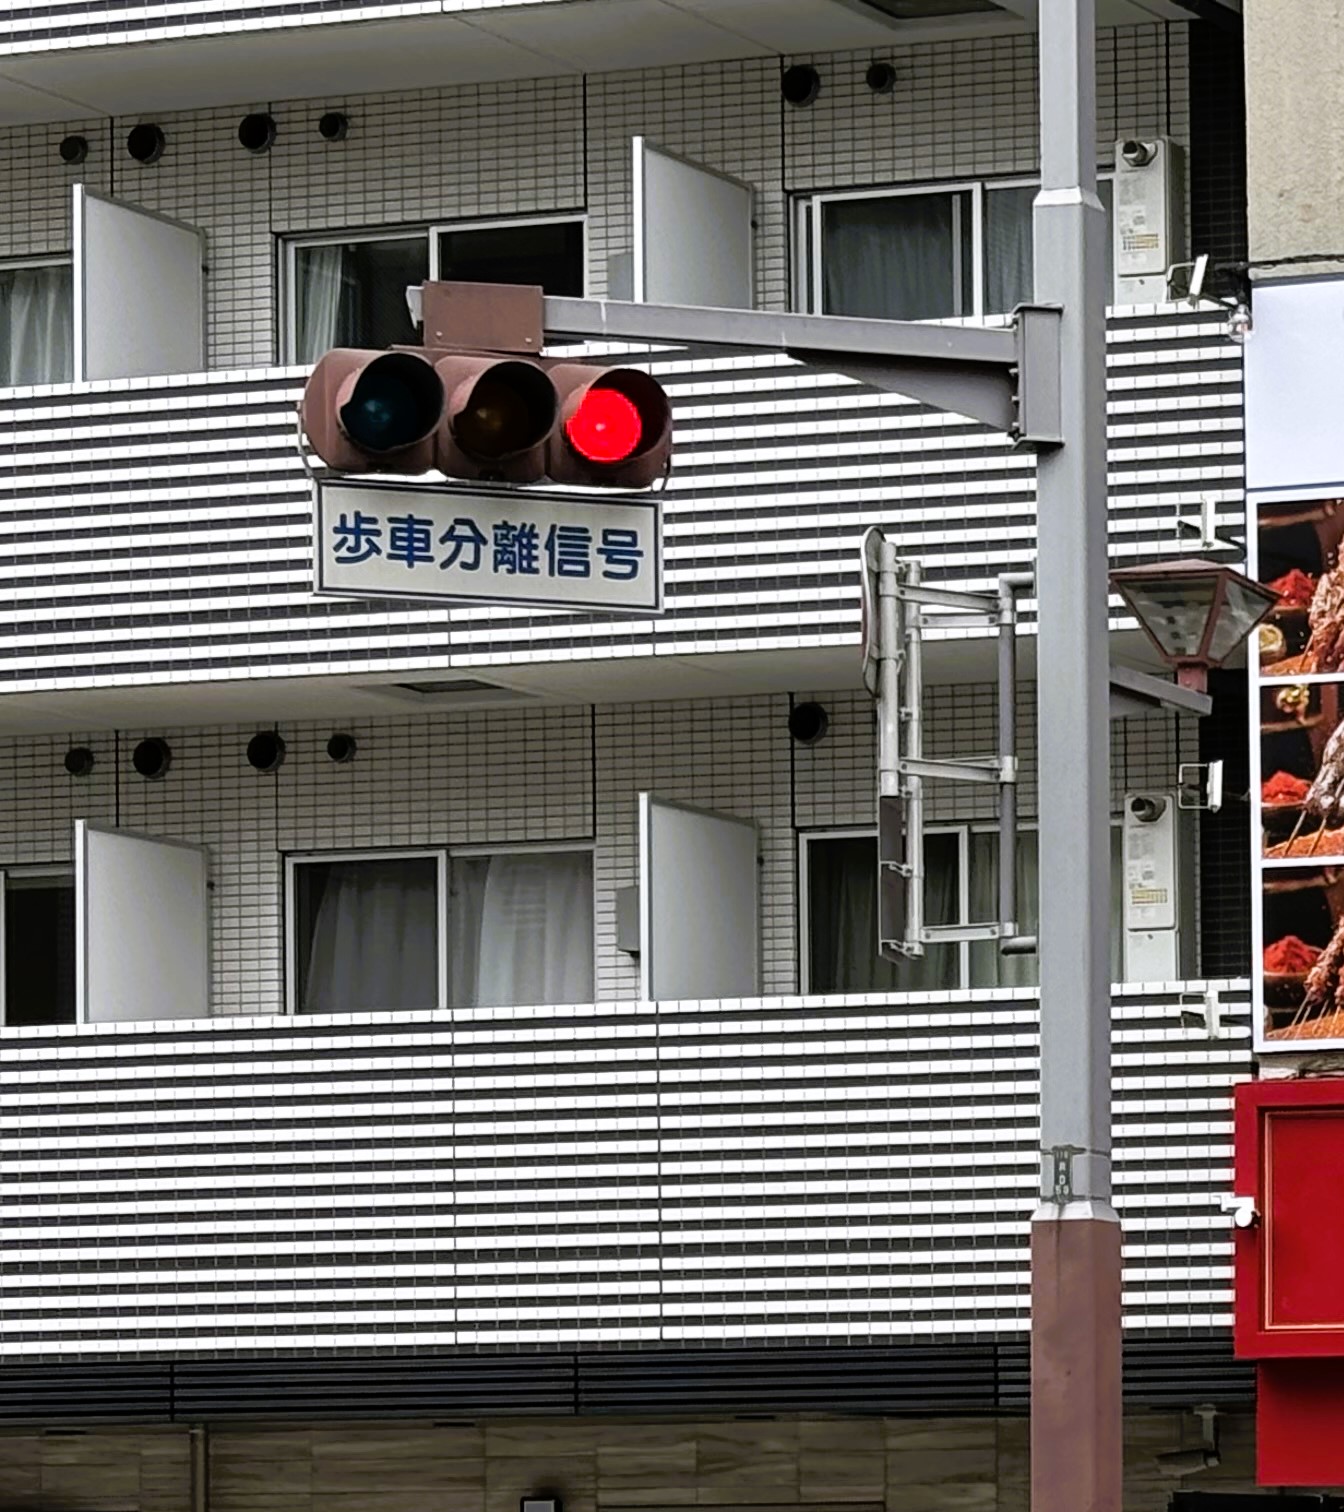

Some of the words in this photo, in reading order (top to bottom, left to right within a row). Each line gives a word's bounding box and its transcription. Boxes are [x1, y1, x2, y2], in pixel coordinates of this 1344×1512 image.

[333, 510, 643, 580] 歩車分離信号
